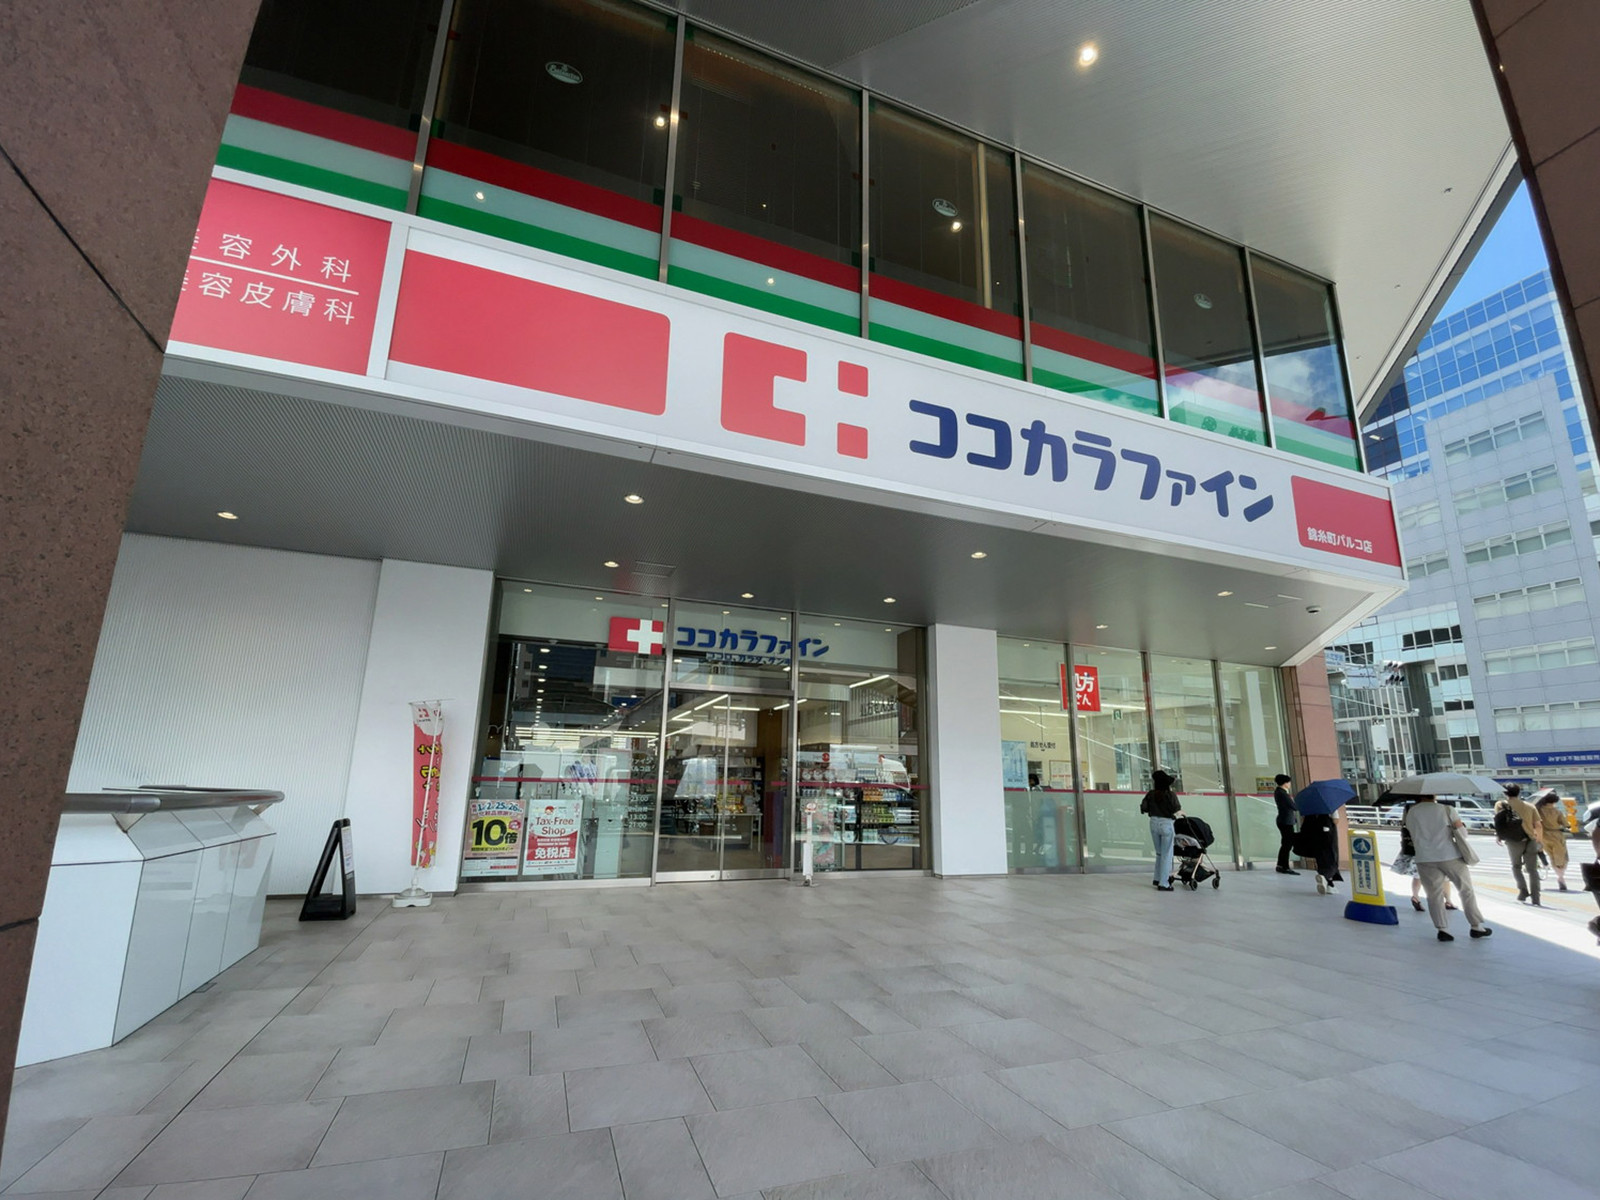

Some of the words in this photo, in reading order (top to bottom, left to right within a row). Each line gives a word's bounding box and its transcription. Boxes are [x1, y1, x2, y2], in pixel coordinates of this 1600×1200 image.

[192, 228, 352, 283] 容外科
[180, 269, 355, 325] 容皮膚科
[909, 399, 1274, 523] ココカラファイン
[1307, 526, 1373, 554] 錦糸町パルコ店
[676, 626, 829, 658] ココカラファイン
[536, 817, 574, 825] Tax-Free
[541, 826, 566, 836] Shop
[534, 846, 571, 859] 免税店
